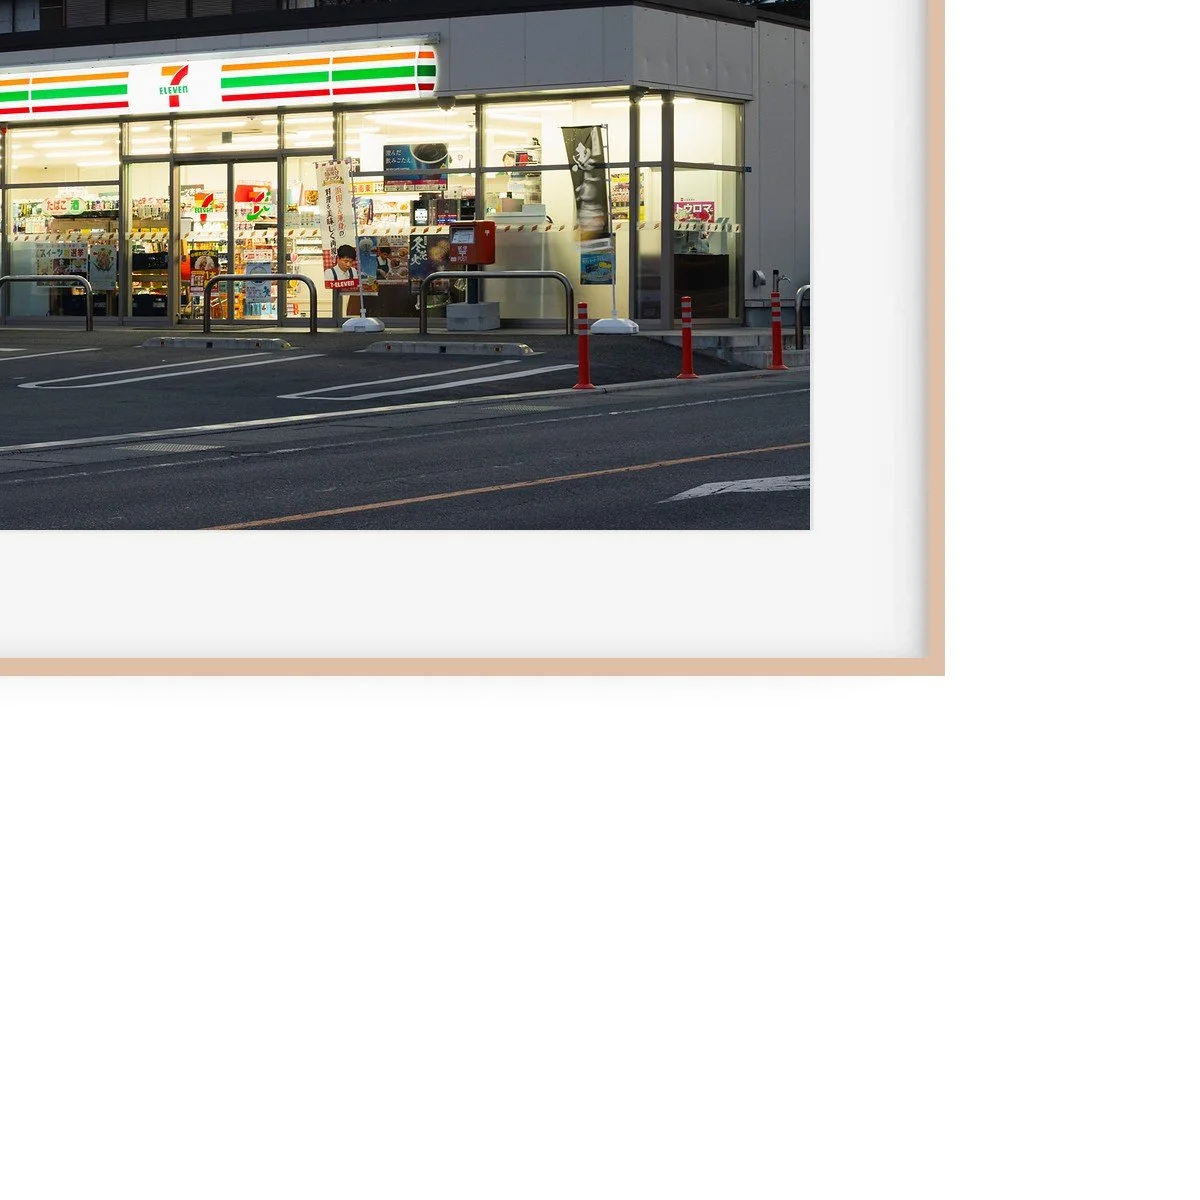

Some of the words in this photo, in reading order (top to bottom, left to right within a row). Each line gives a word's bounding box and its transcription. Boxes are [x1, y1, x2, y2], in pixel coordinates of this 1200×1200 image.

[161, 64, 189, 108] 7
[46, 200, 67, 211] たばこ
